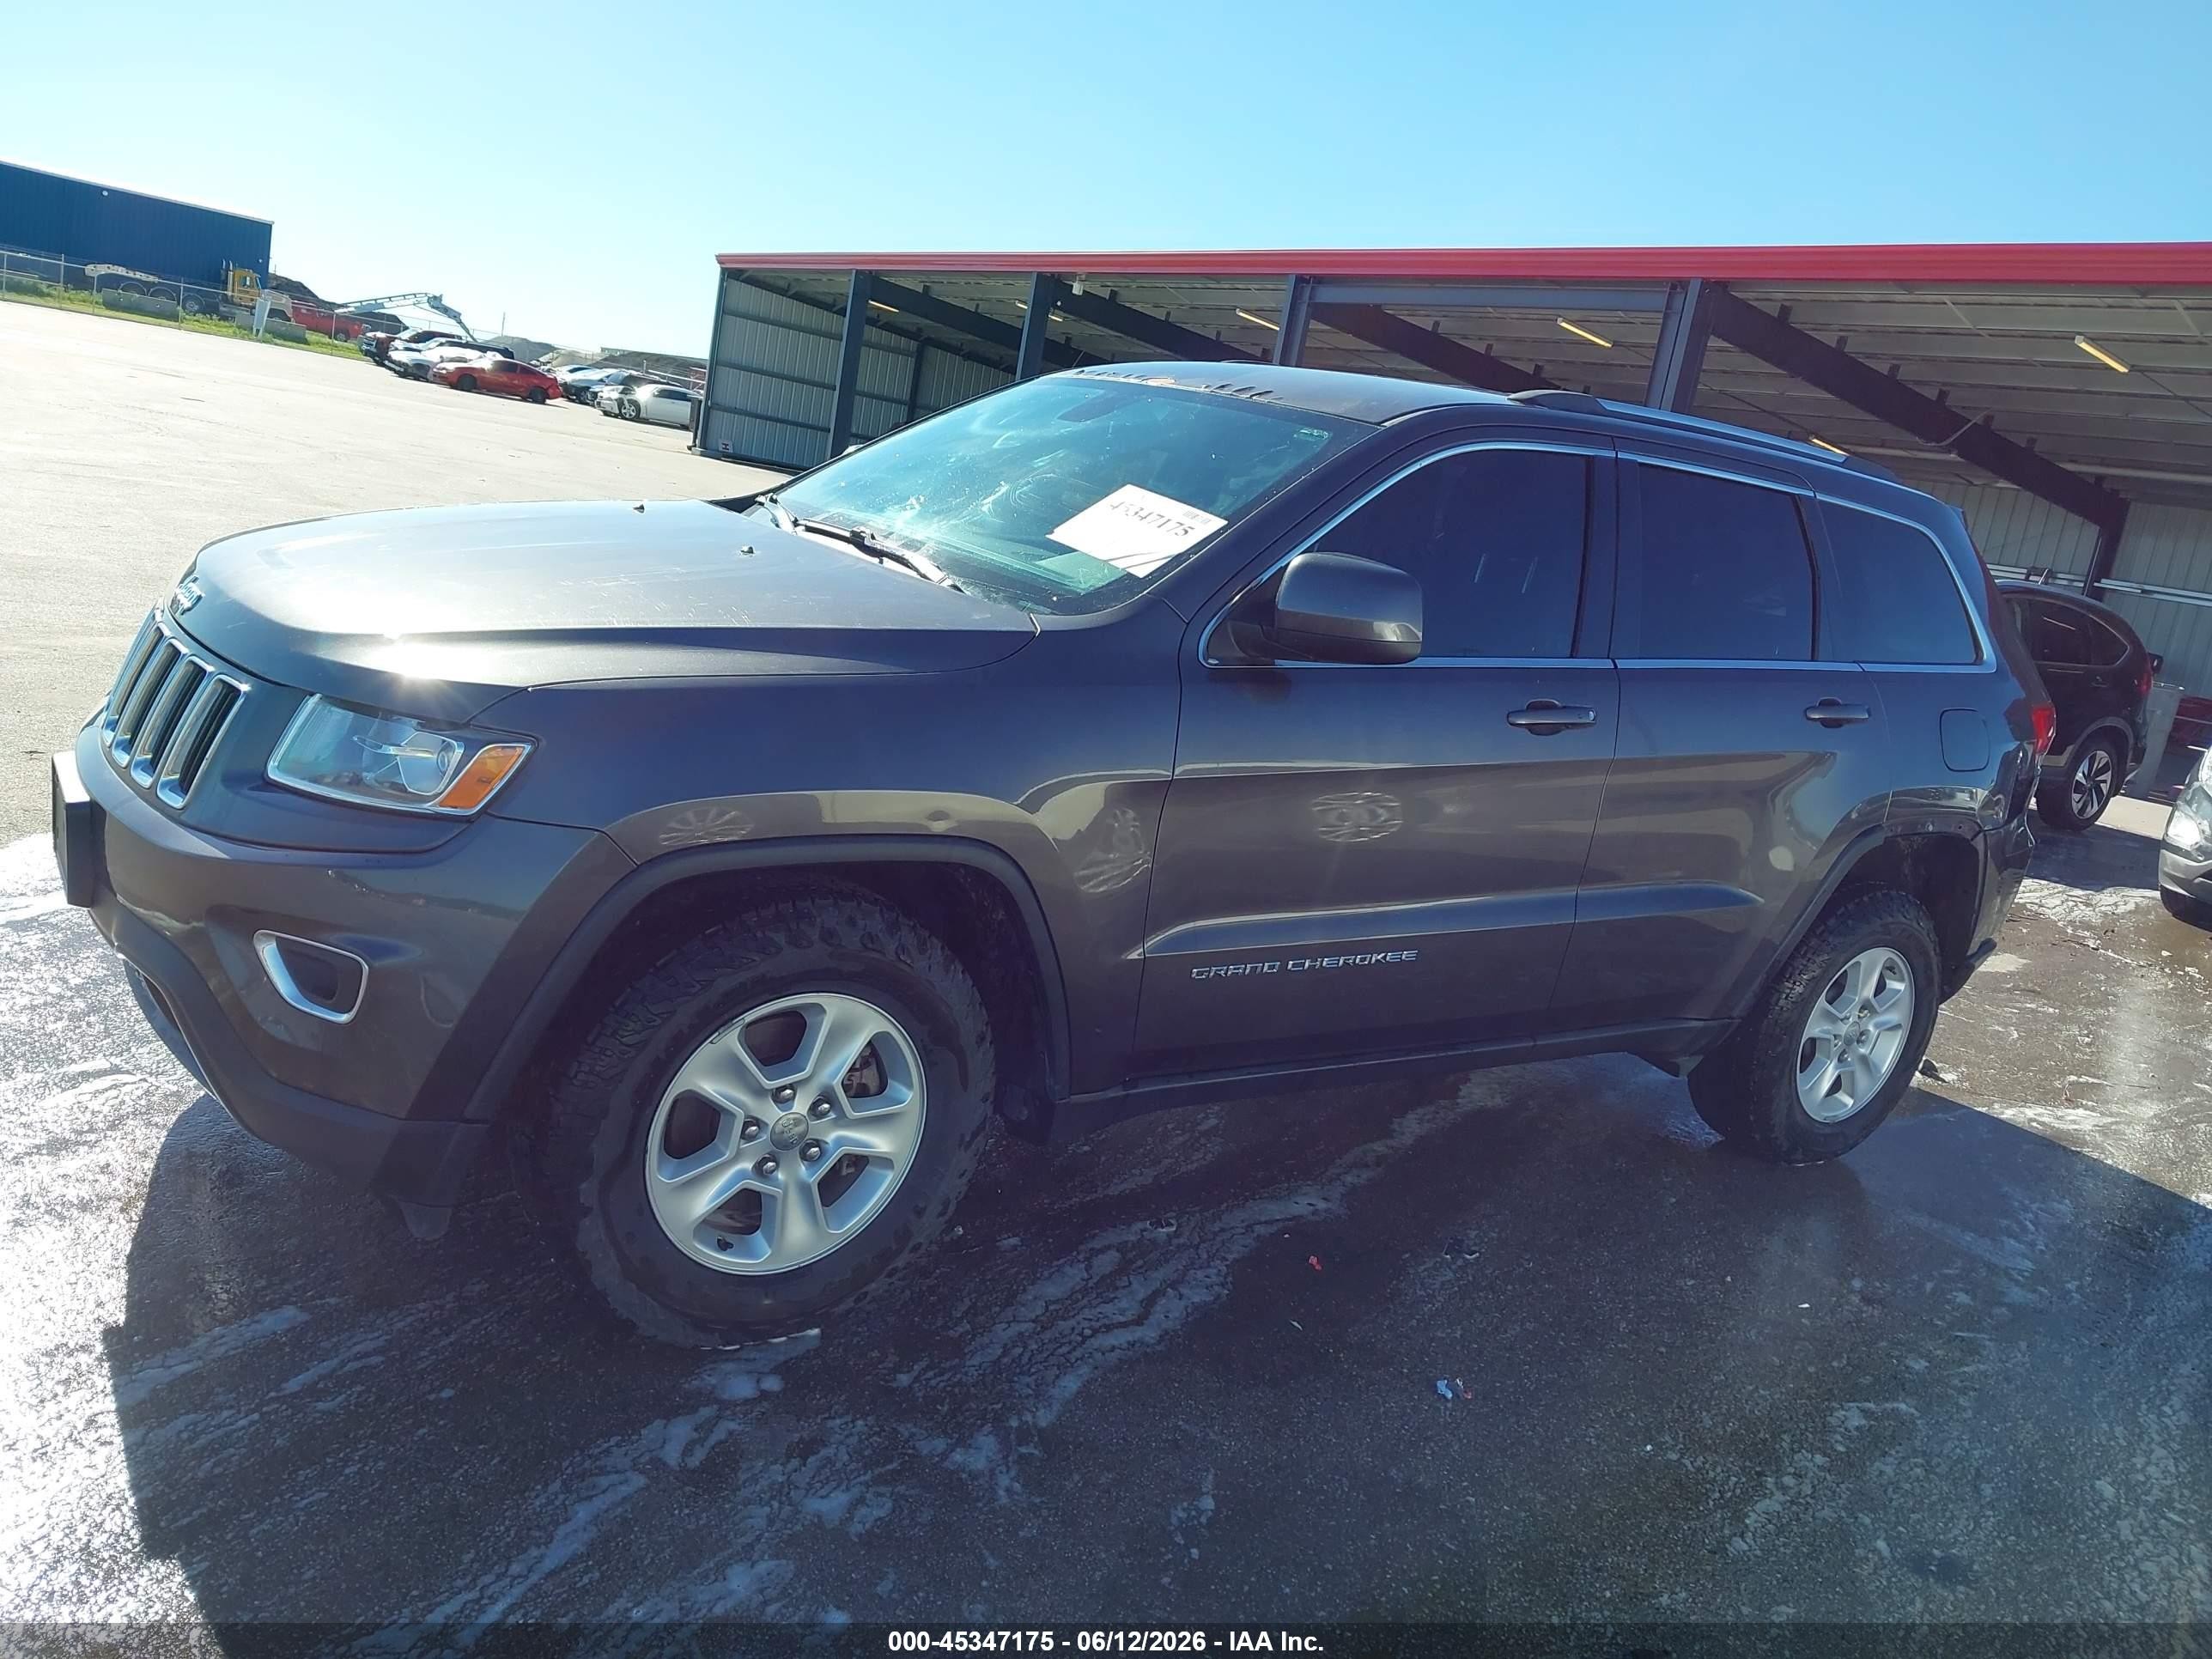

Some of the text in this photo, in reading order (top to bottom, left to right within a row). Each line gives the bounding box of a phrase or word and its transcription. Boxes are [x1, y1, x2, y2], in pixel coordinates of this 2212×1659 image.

[1109, 501, 1196, 537] 45347175
[1191, 950, 1419, 980] GRAND CHEROKEE
